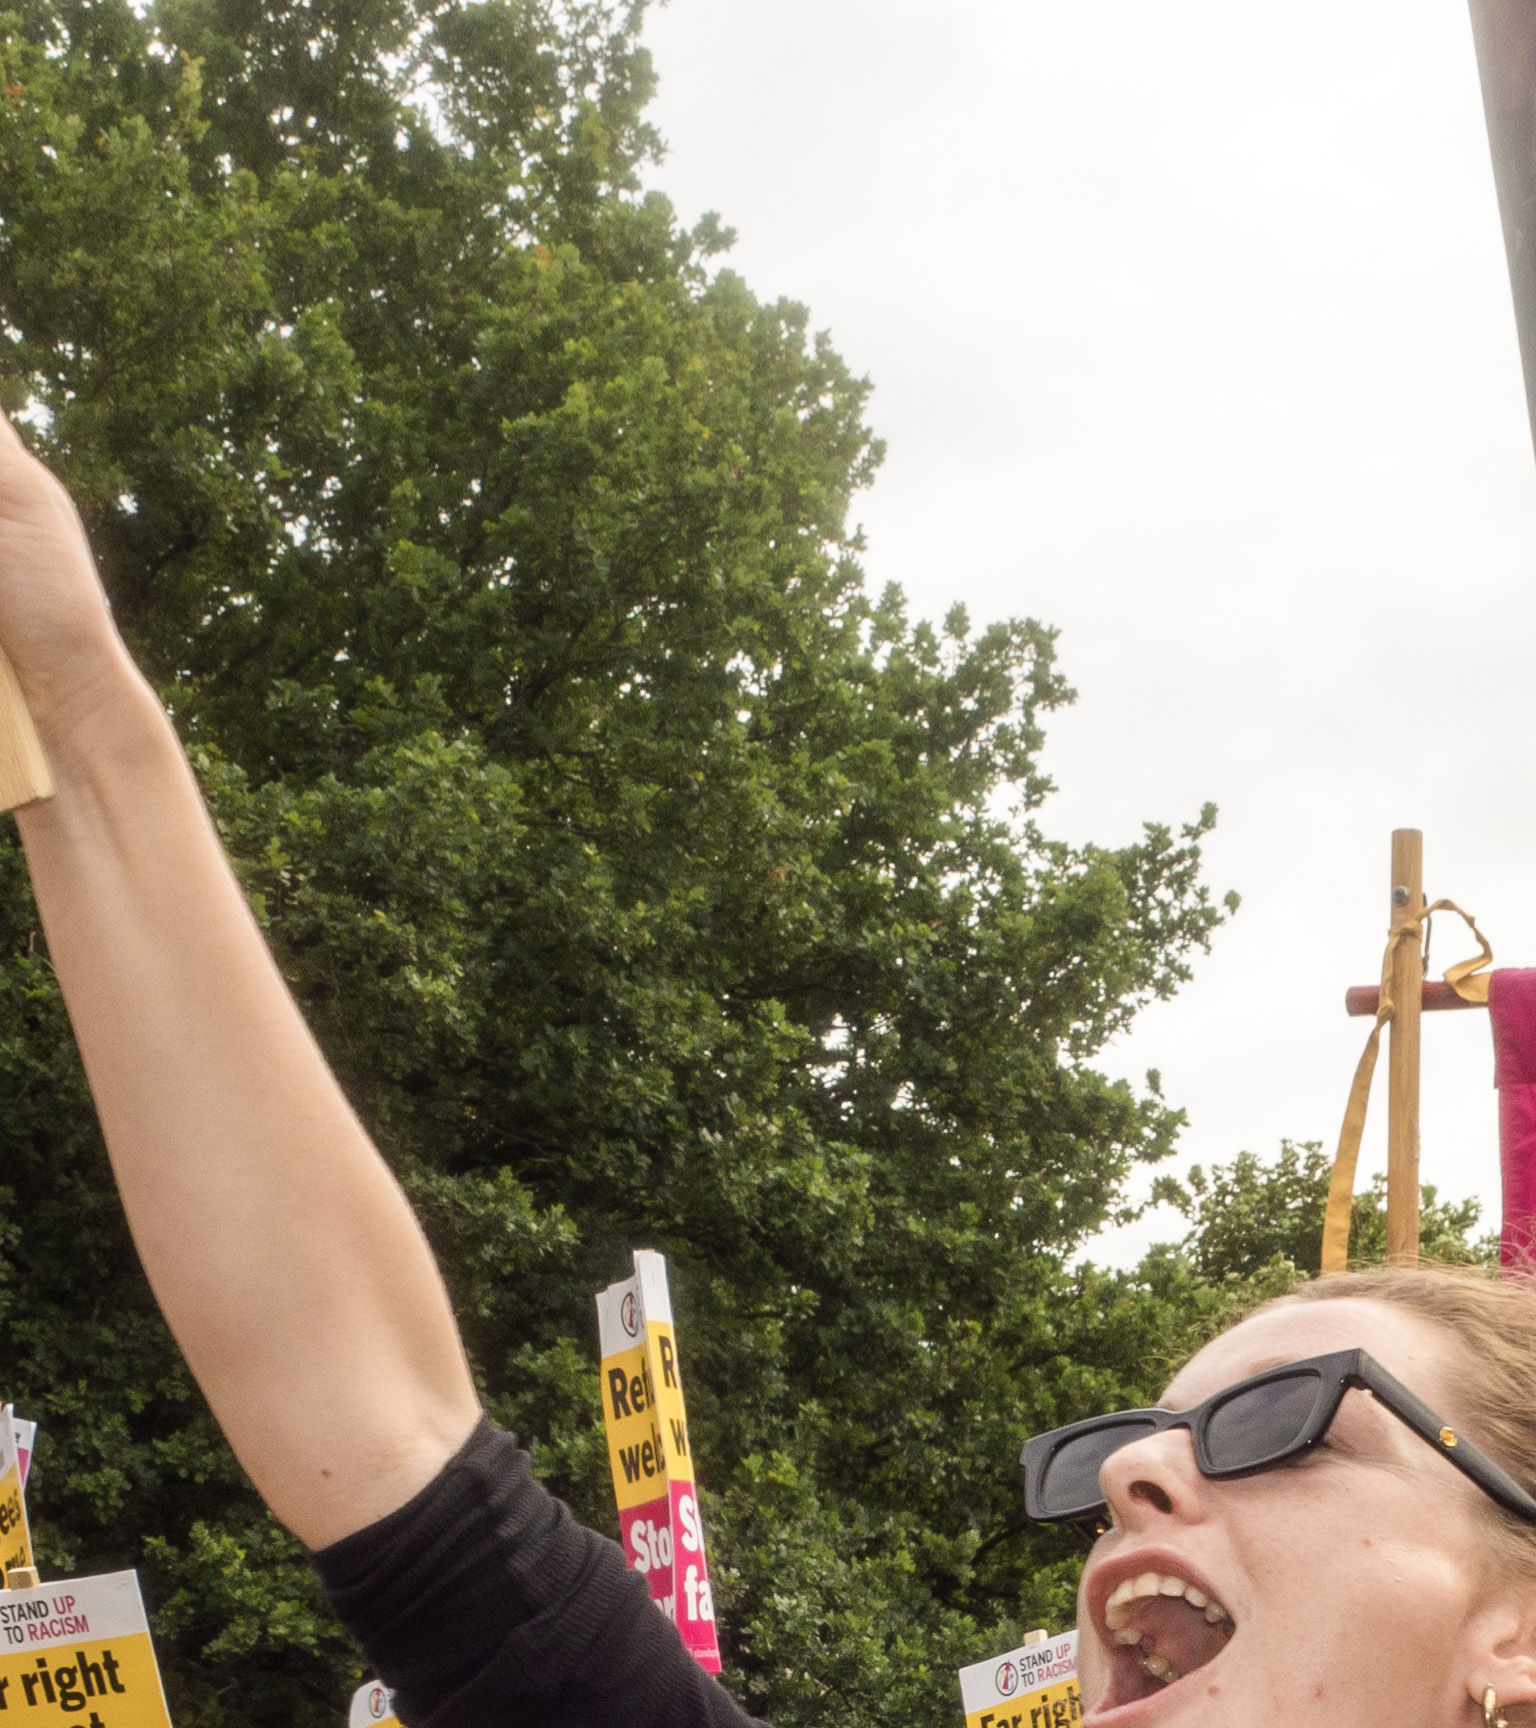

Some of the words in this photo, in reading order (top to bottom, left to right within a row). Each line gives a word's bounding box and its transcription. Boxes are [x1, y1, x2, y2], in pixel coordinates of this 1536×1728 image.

[630, 1519, 672, 1574] Sto
[684, 1564, 715, 1621] fa
[0, 1600, 49, 1625] STAND
[52, 1595, 75, 1616] UP
[4, 1625, 24, 1645] TO
[28, 1614, 90, 1642] RACISM
[1019, 1649, 1053, 1672] STAND
[1055, 1643, 1071, 1660] UP
[1021, 1671, 1035, 1688] TO
[1037, 1657, 1076, 1683] RACISM
[20, 1650, 126, 1712] right
